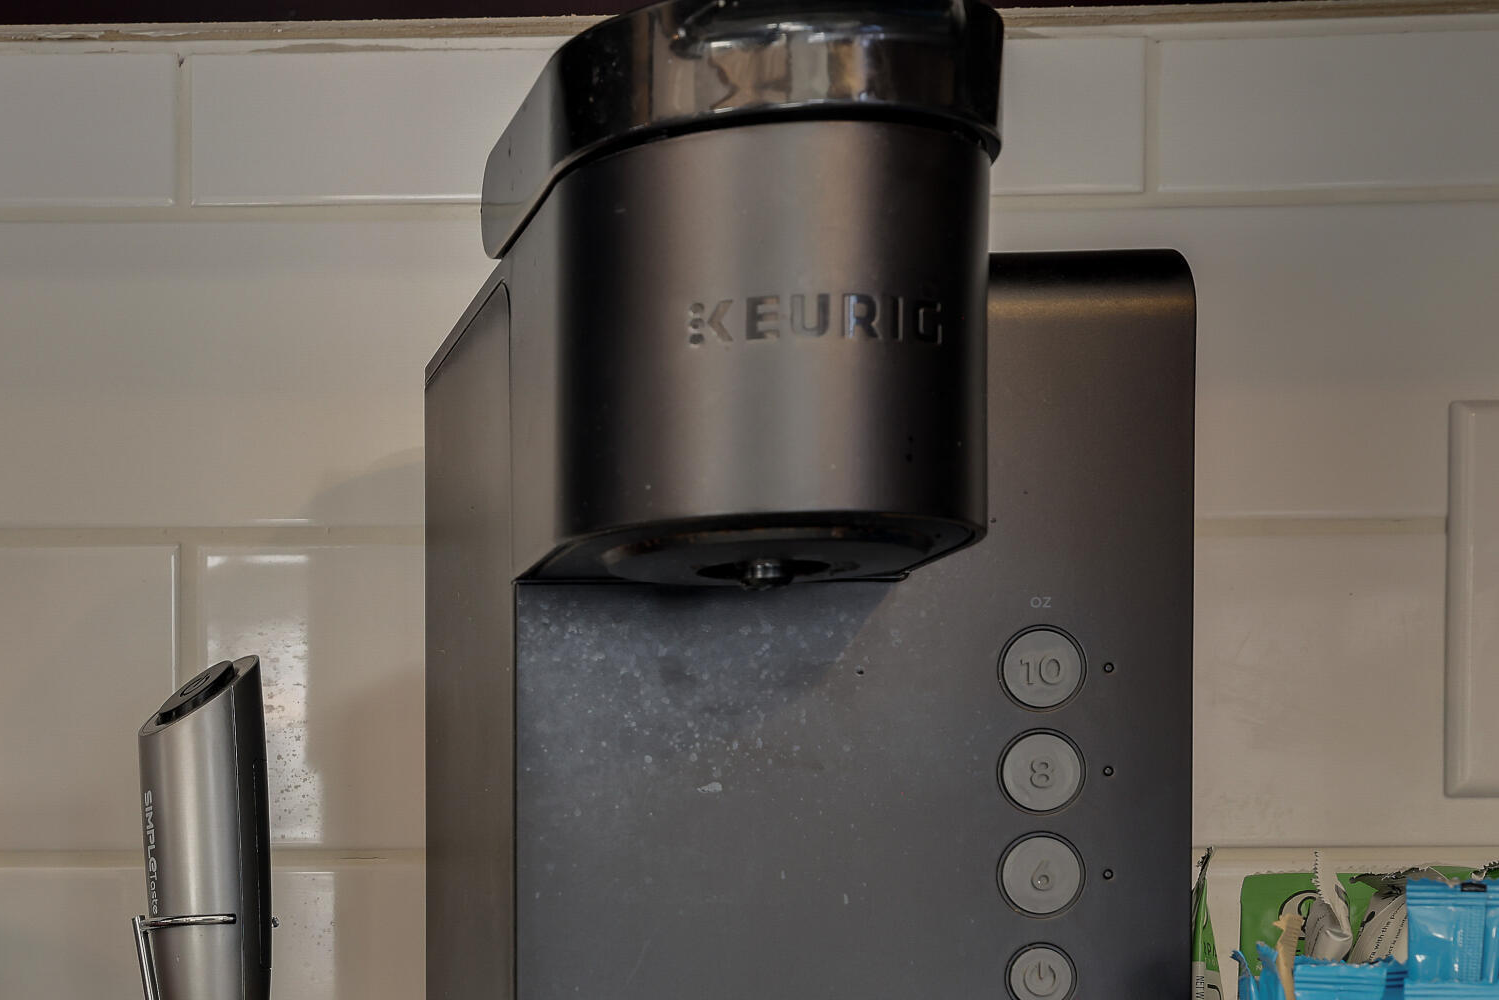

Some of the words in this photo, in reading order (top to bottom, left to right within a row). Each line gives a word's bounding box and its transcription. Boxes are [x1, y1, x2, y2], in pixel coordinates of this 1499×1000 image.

[688, 293, 944, 345] KEURIG
[1030, 597, 1052, 608] OZ
[1020, 658, 1061, 685] 10
[1029, 759, 1054, 789] 8
[1030, 860, 1054, 891] 6
[1196, 976, 1204, 989] NET
